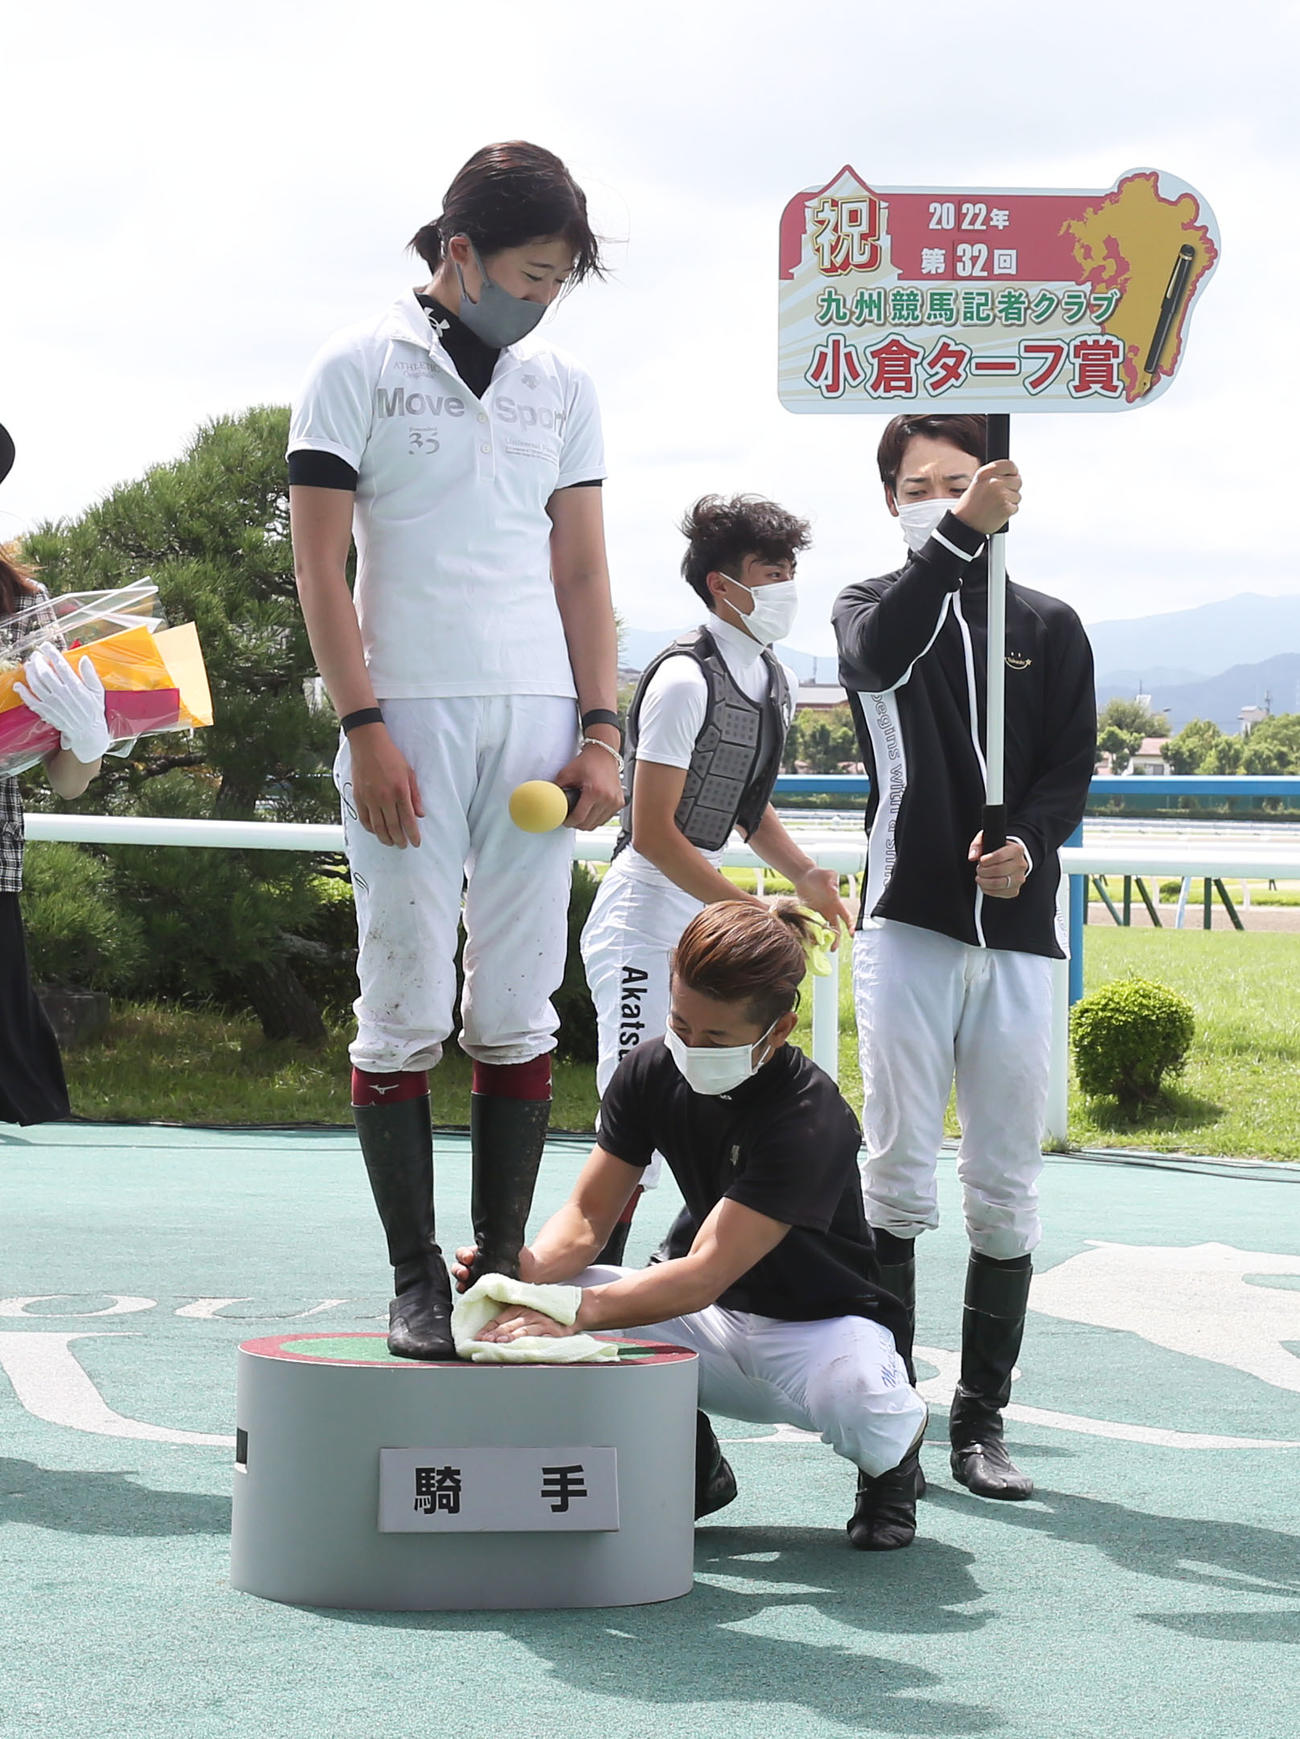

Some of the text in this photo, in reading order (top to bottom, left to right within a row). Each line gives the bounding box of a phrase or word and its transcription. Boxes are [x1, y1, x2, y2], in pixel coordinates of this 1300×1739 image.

[928, 202, 1010, 231] 2022年
[813, 197, 881, 276] 祝
[920, 242, 1017, 277] 第32回
[816, 287, 1121, 326] 九州競馬記者クラブ
[805, 333, 1125, 398] 小倉ターフ賞
[376, 387, 465, 418] Move
[414, 1465, 587, 1514] 騎手
